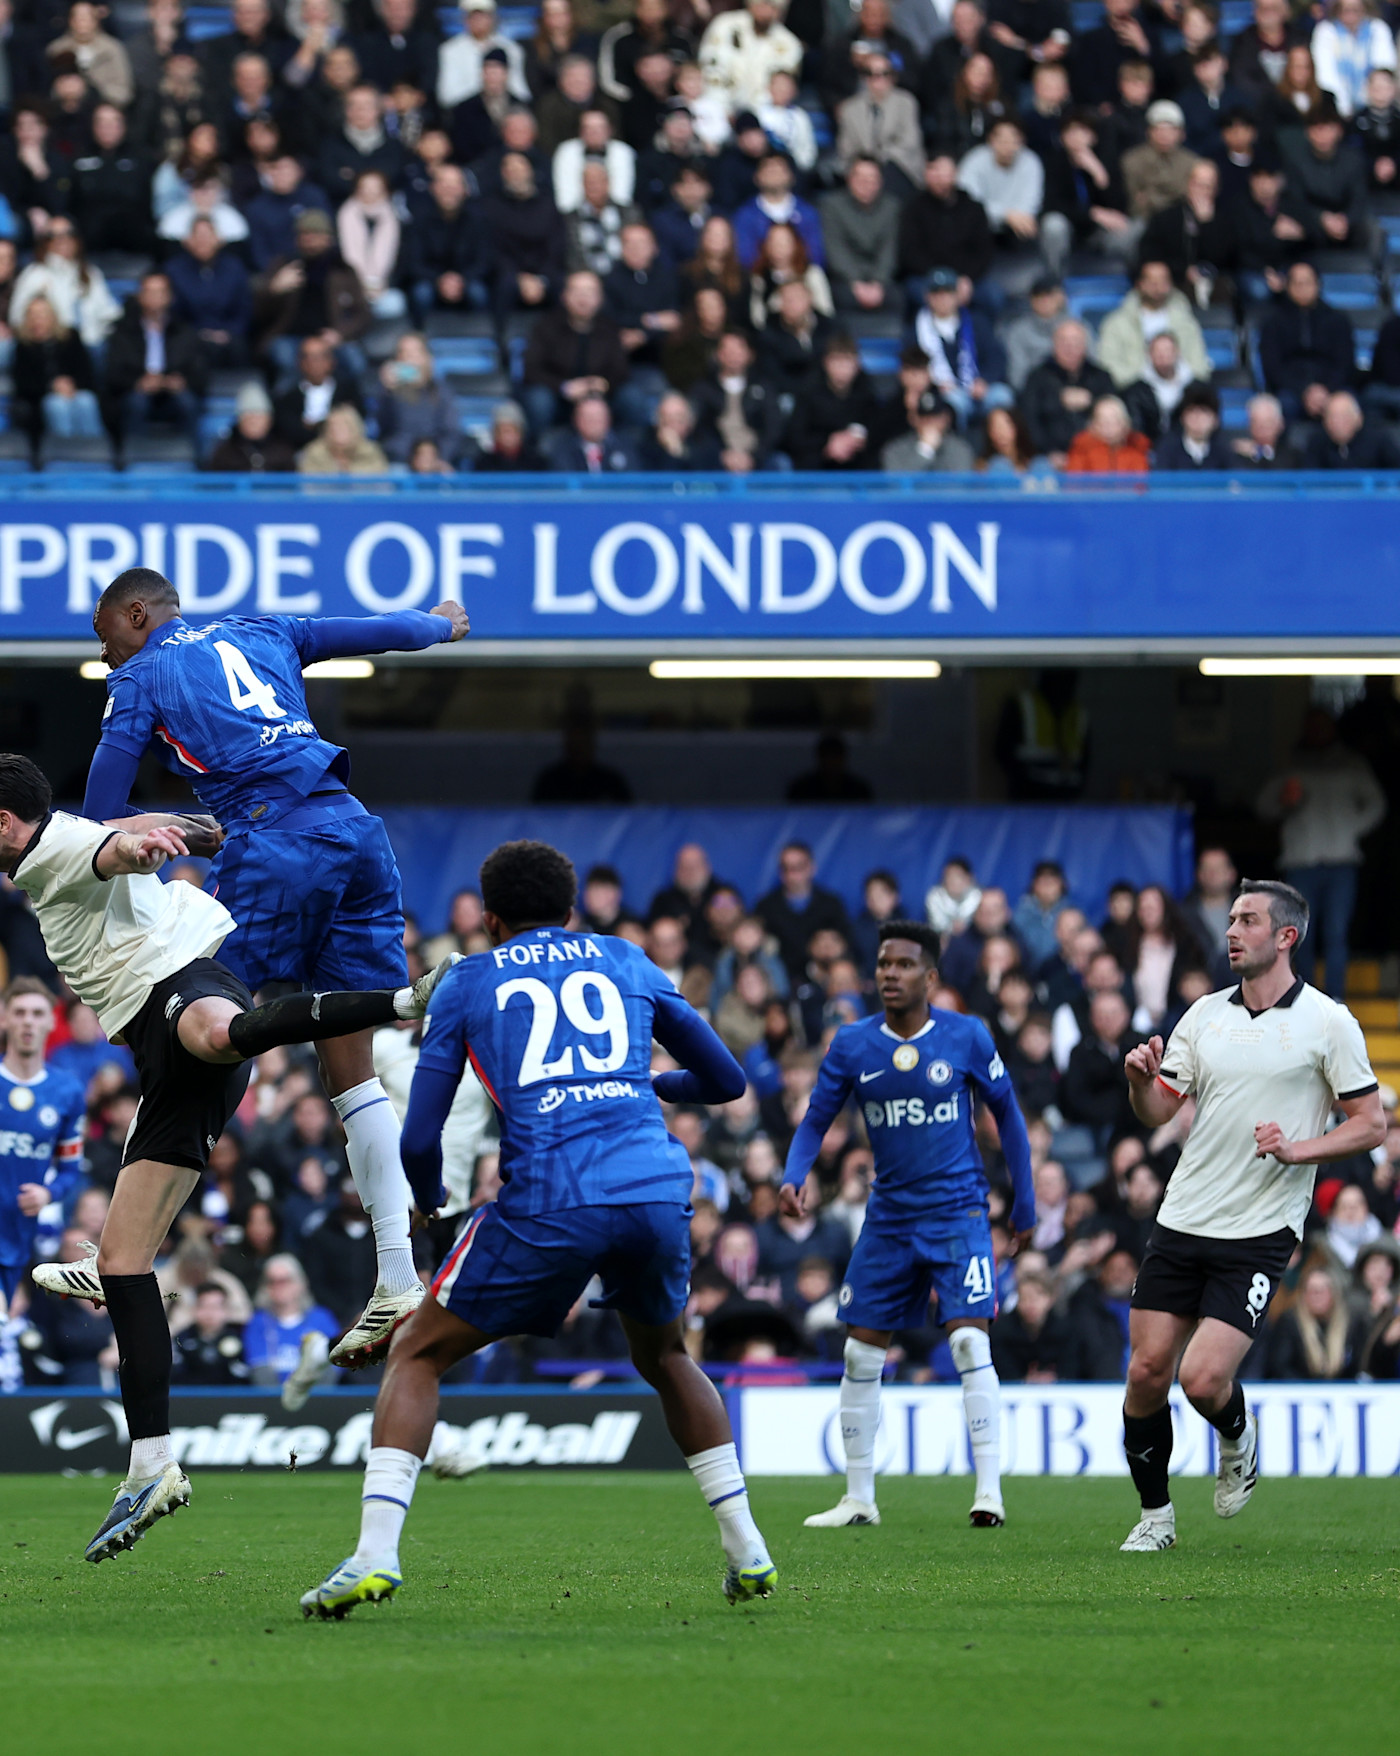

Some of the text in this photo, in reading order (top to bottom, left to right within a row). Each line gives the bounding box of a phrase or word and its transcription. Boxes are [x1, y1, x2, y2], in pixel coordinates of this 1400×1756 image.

[345, 520, 502, 613] OF
[533, 521, 998, 616] LONDON
[213, 640, 288, 719] 4
[493, 939, 604, 969] FOFANA
[495, 971, 629, 1087] 29
[885, 1091, 959, 1128] IFS.ai
[963, 1256, 991, 1293] 41
[1247, 1272, 1271, 1311] 8
[166, 1411, 642, 1466] nike ftball
